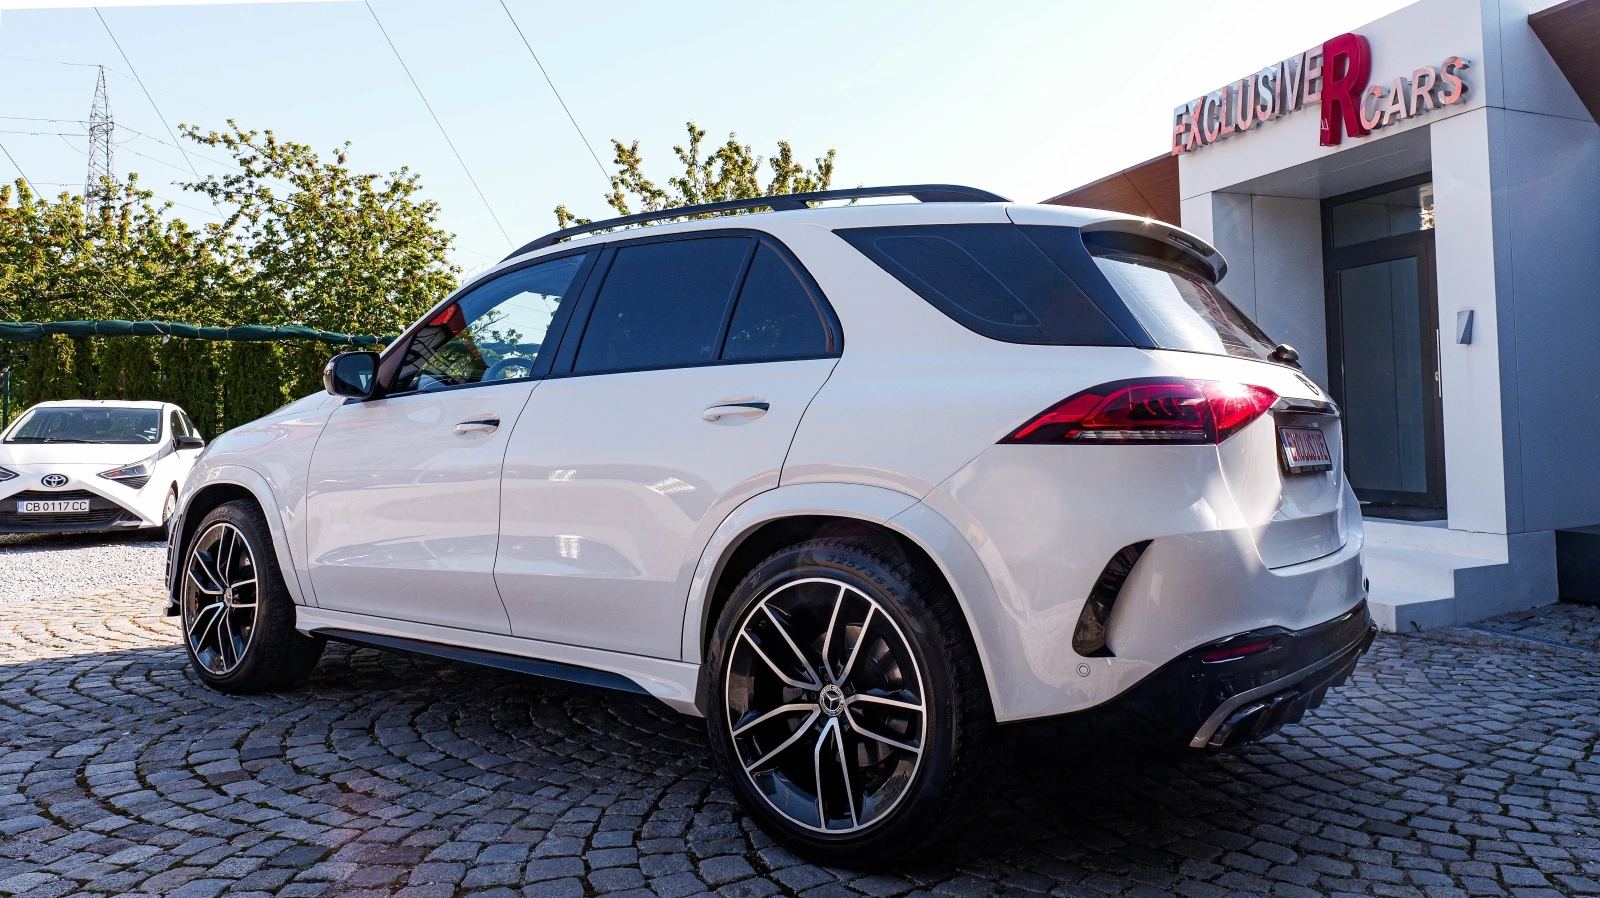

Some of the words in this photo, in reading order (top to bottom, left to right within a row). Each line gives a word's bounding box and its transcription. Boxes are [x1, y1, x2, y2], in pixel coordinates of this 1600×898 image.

[1172, 44, 1323, 156] EXCLUSIVE
[1319, 33, 1371, 146] R
[1360, 56, 1470, 131] CARS
[26, 502, 40, 511] CB
[43, 502, 70, 511] 0117
[72, 501, 87, 511] CC
[826, 555, 886, 585] 325/35
